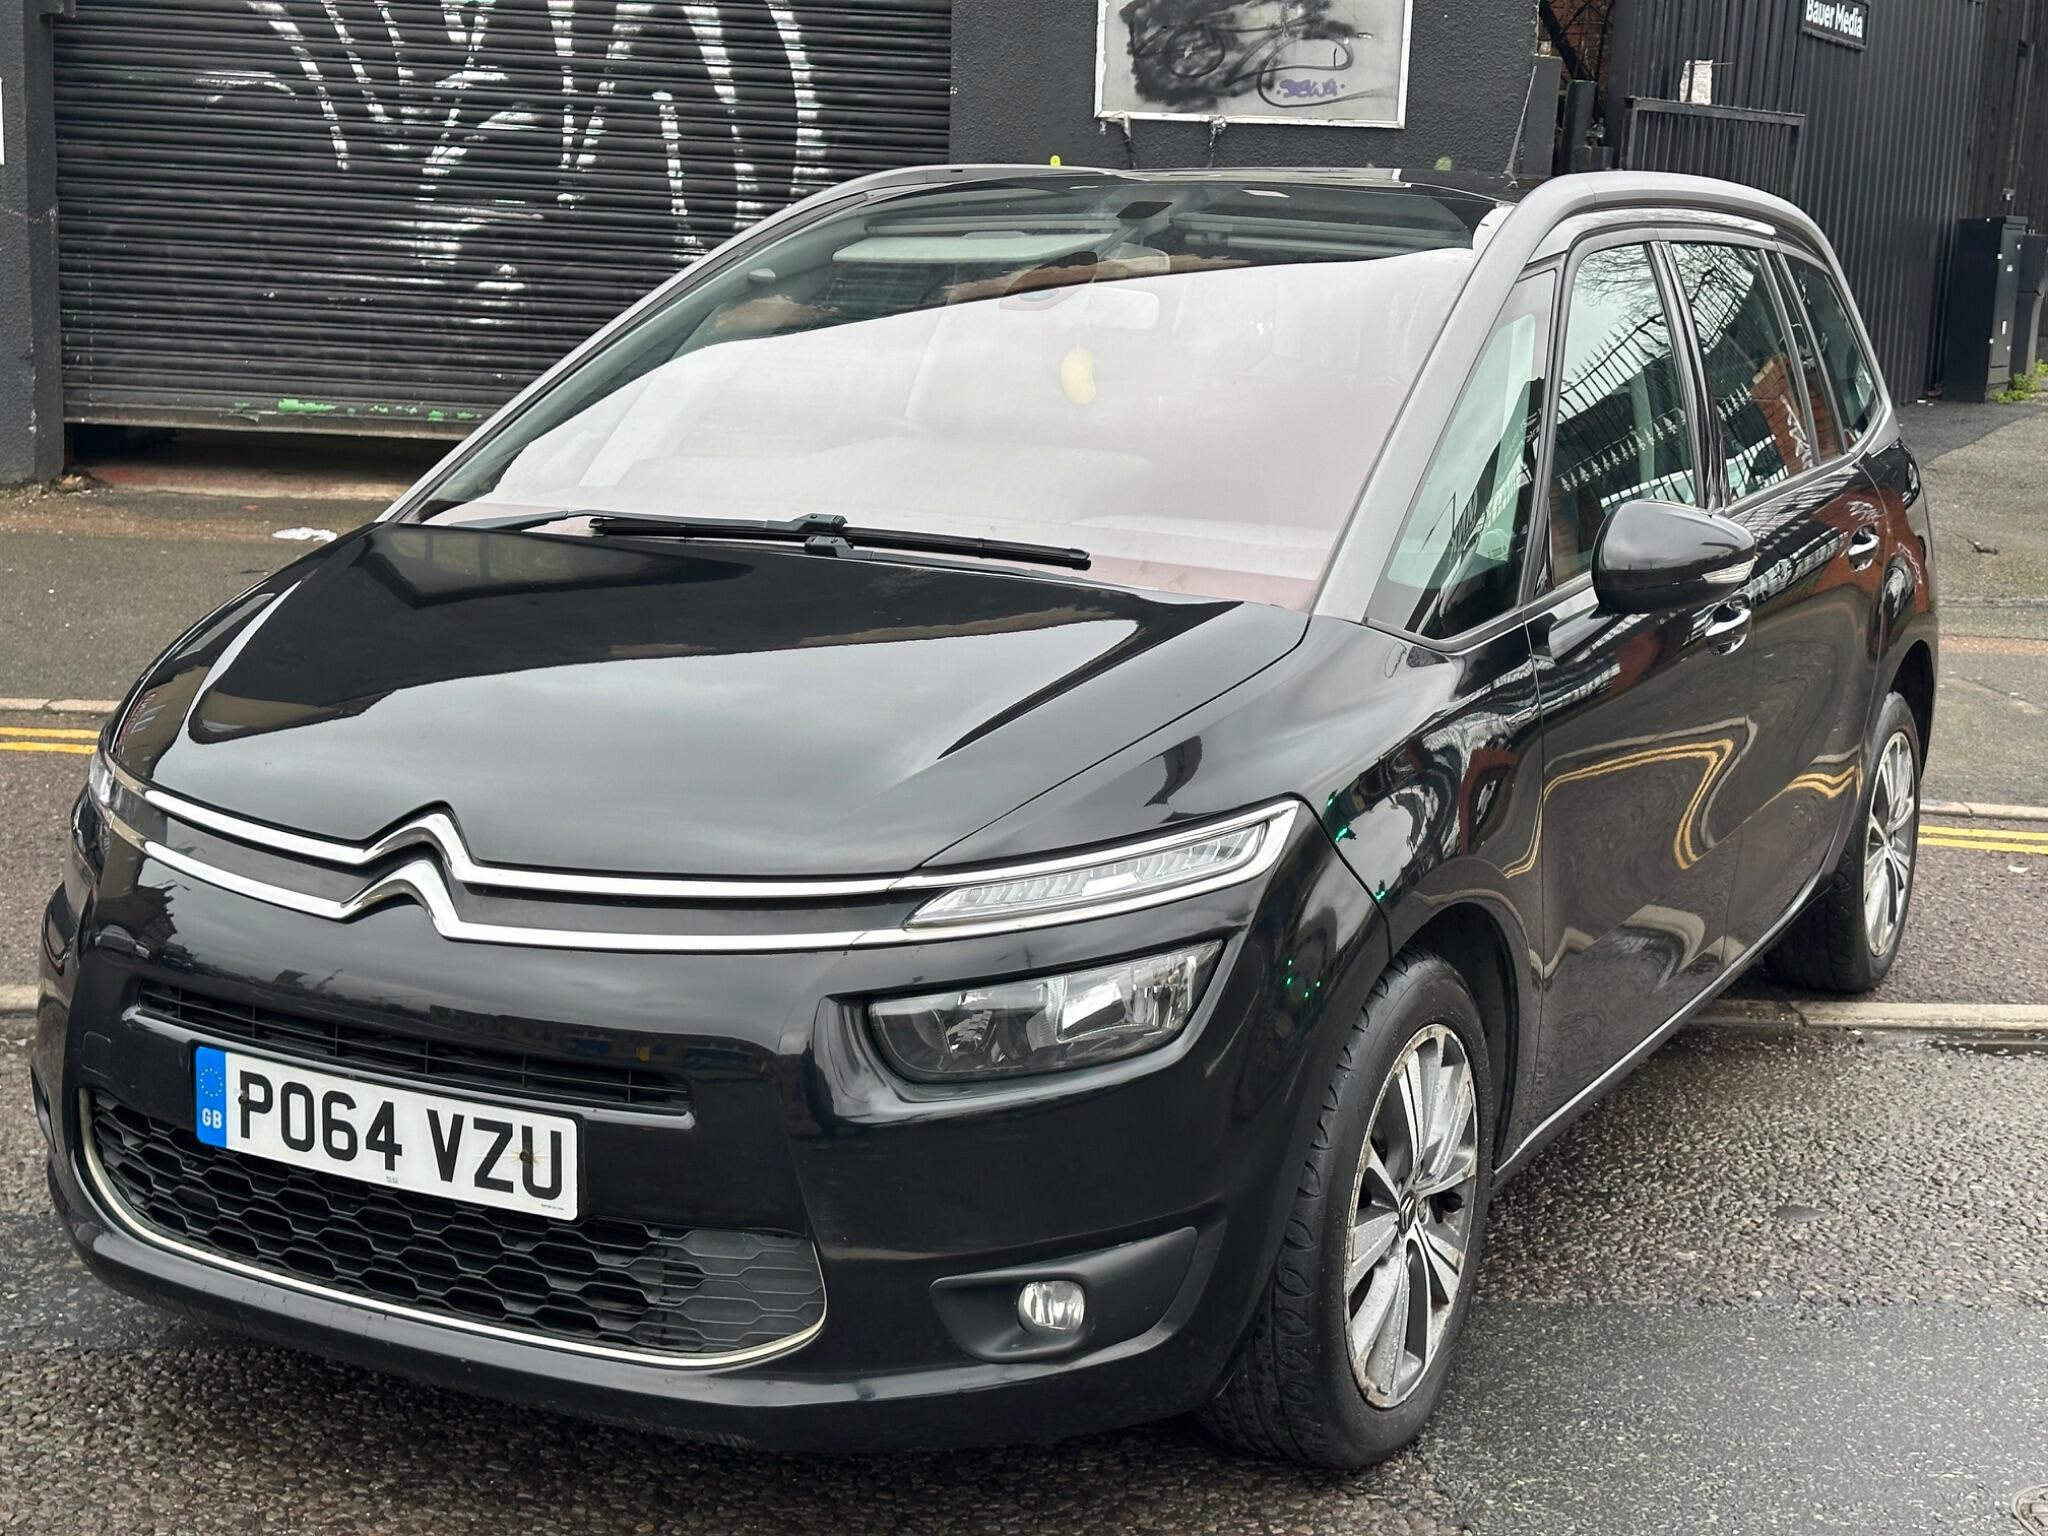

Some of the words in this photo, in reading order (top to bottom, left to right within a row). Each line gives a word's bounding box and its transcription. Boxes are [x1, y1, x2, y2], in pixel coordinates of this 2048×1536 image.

[1806, 0, 1835, 28] Bauer
[1835, 3, 1862, 38] Media
[202, 1108, 222, 1129] GB
[238, 1070, 403, 1171] PO64
[427, 1109, 562, 1200] VZU
